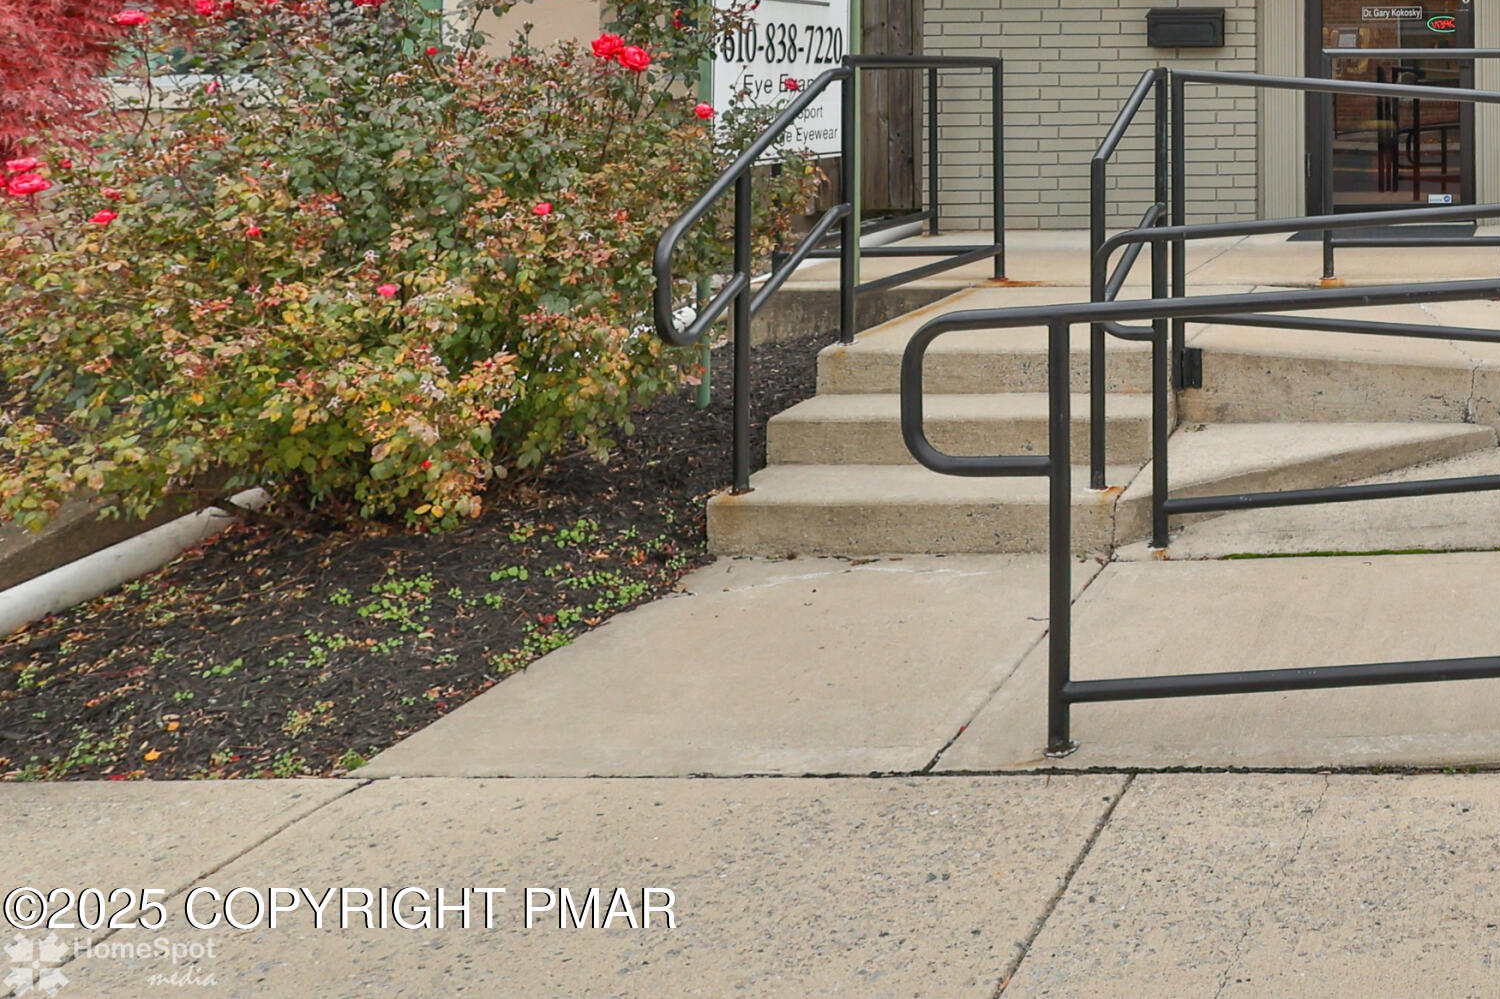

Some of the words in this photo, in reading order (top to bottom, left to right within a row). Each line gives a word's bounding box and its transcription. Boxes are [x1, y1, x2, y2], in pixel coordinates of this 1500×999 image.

[1373, 8, 1390, 19] Gary
[1391, 8, 1421, 19] Kokosky
[721, 20, 843, 64] 610-838-7220
[743, 74, 773, 99] Eye
[796, 127, 838, 145] Eyewear
